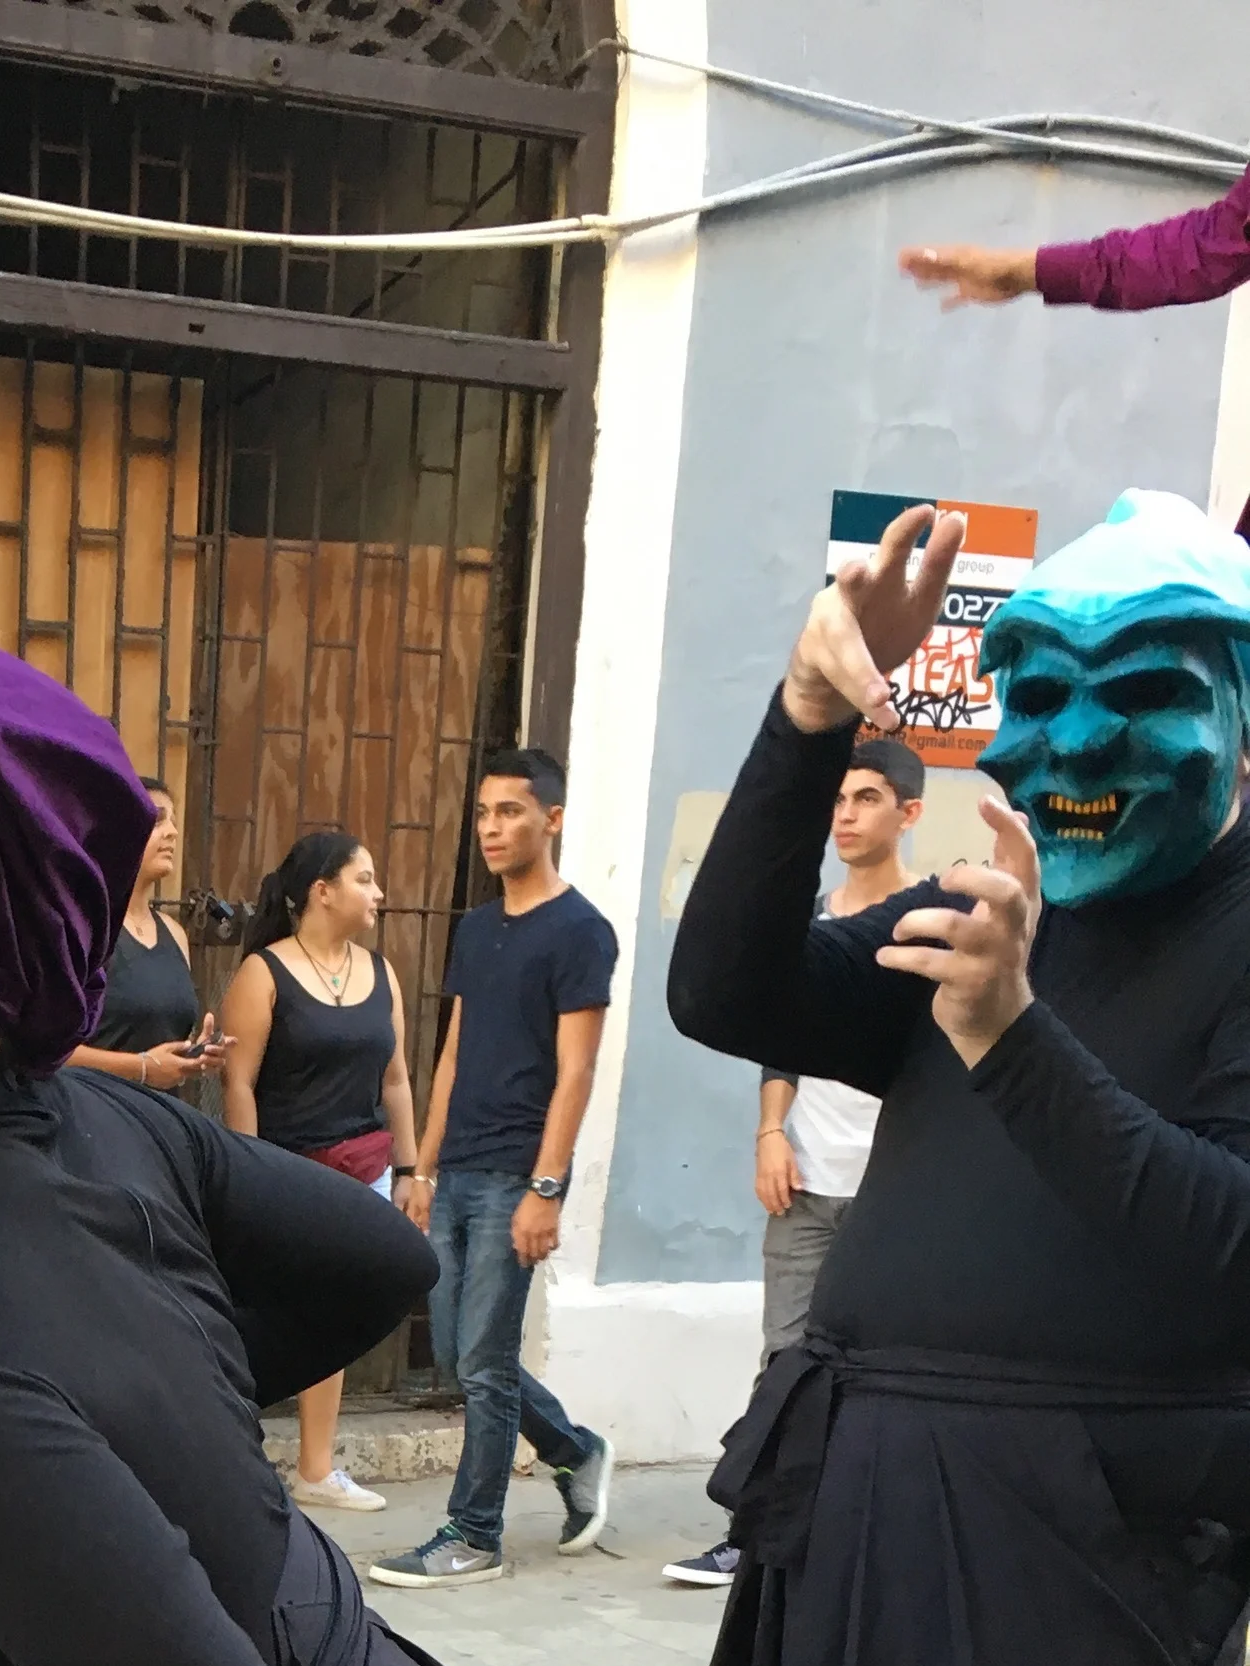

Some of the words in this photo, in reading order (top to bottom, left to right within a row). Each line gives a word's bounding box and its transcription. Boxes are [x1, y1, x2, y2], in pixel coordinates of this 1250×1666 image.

[957, 559, 995, 574] group
[944, 592, 1009, 622] 027
[908, 652, 993, 703] LEAS
